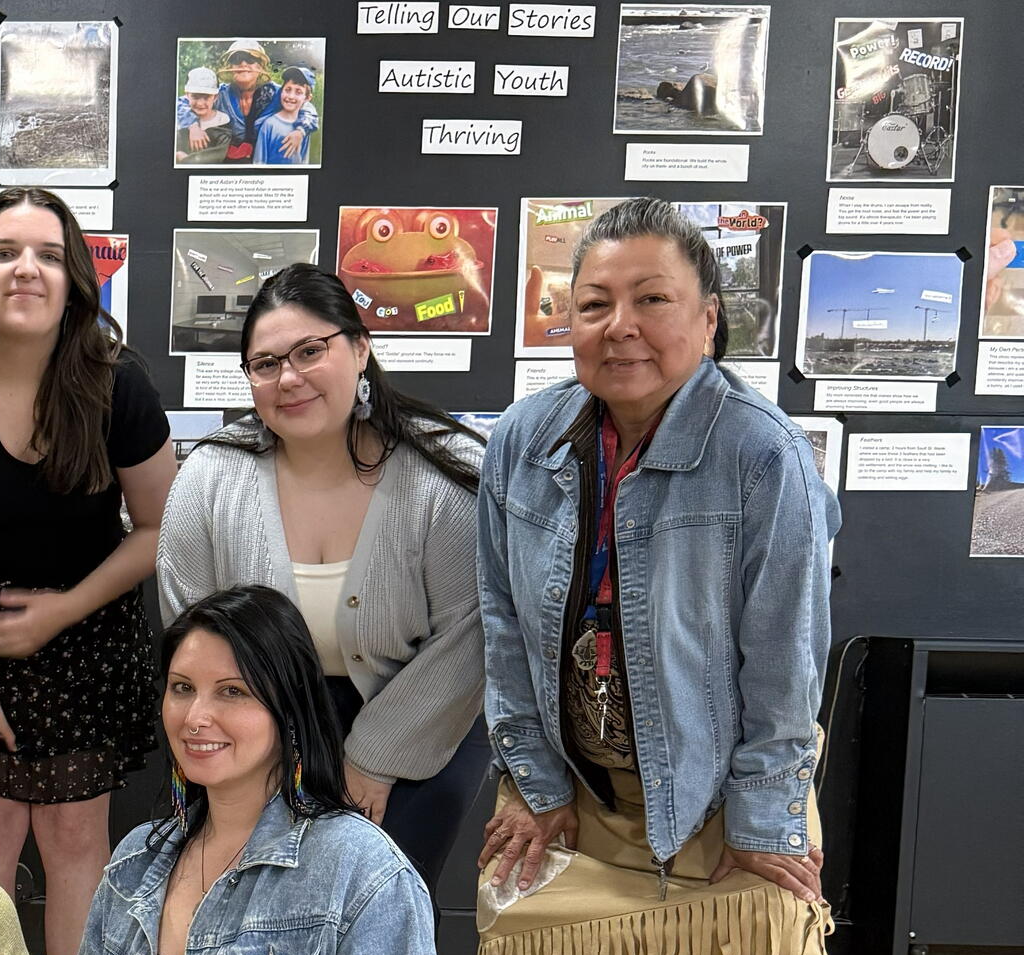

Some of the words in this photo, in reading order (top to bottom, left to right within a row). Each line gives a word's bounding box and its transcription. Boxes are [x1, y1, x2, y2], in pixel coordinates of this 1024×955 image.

[360, 4, 435, 31] Telling
[452, 8, 497, 26] Our
[510, 8, 592, 31] Stories
[899, 47, 953, 72] RECORD!
[381, 67, 473, 88] Autistic
[497, 70, 564, 92] Youth
[424, 124, 520, 153] Thriving
[536, 201, 593, 224] Animal
[716, 247, 725, 258] OF
[726, 243, 752, 257] POWER
[417, 296, 455, 321] Food
